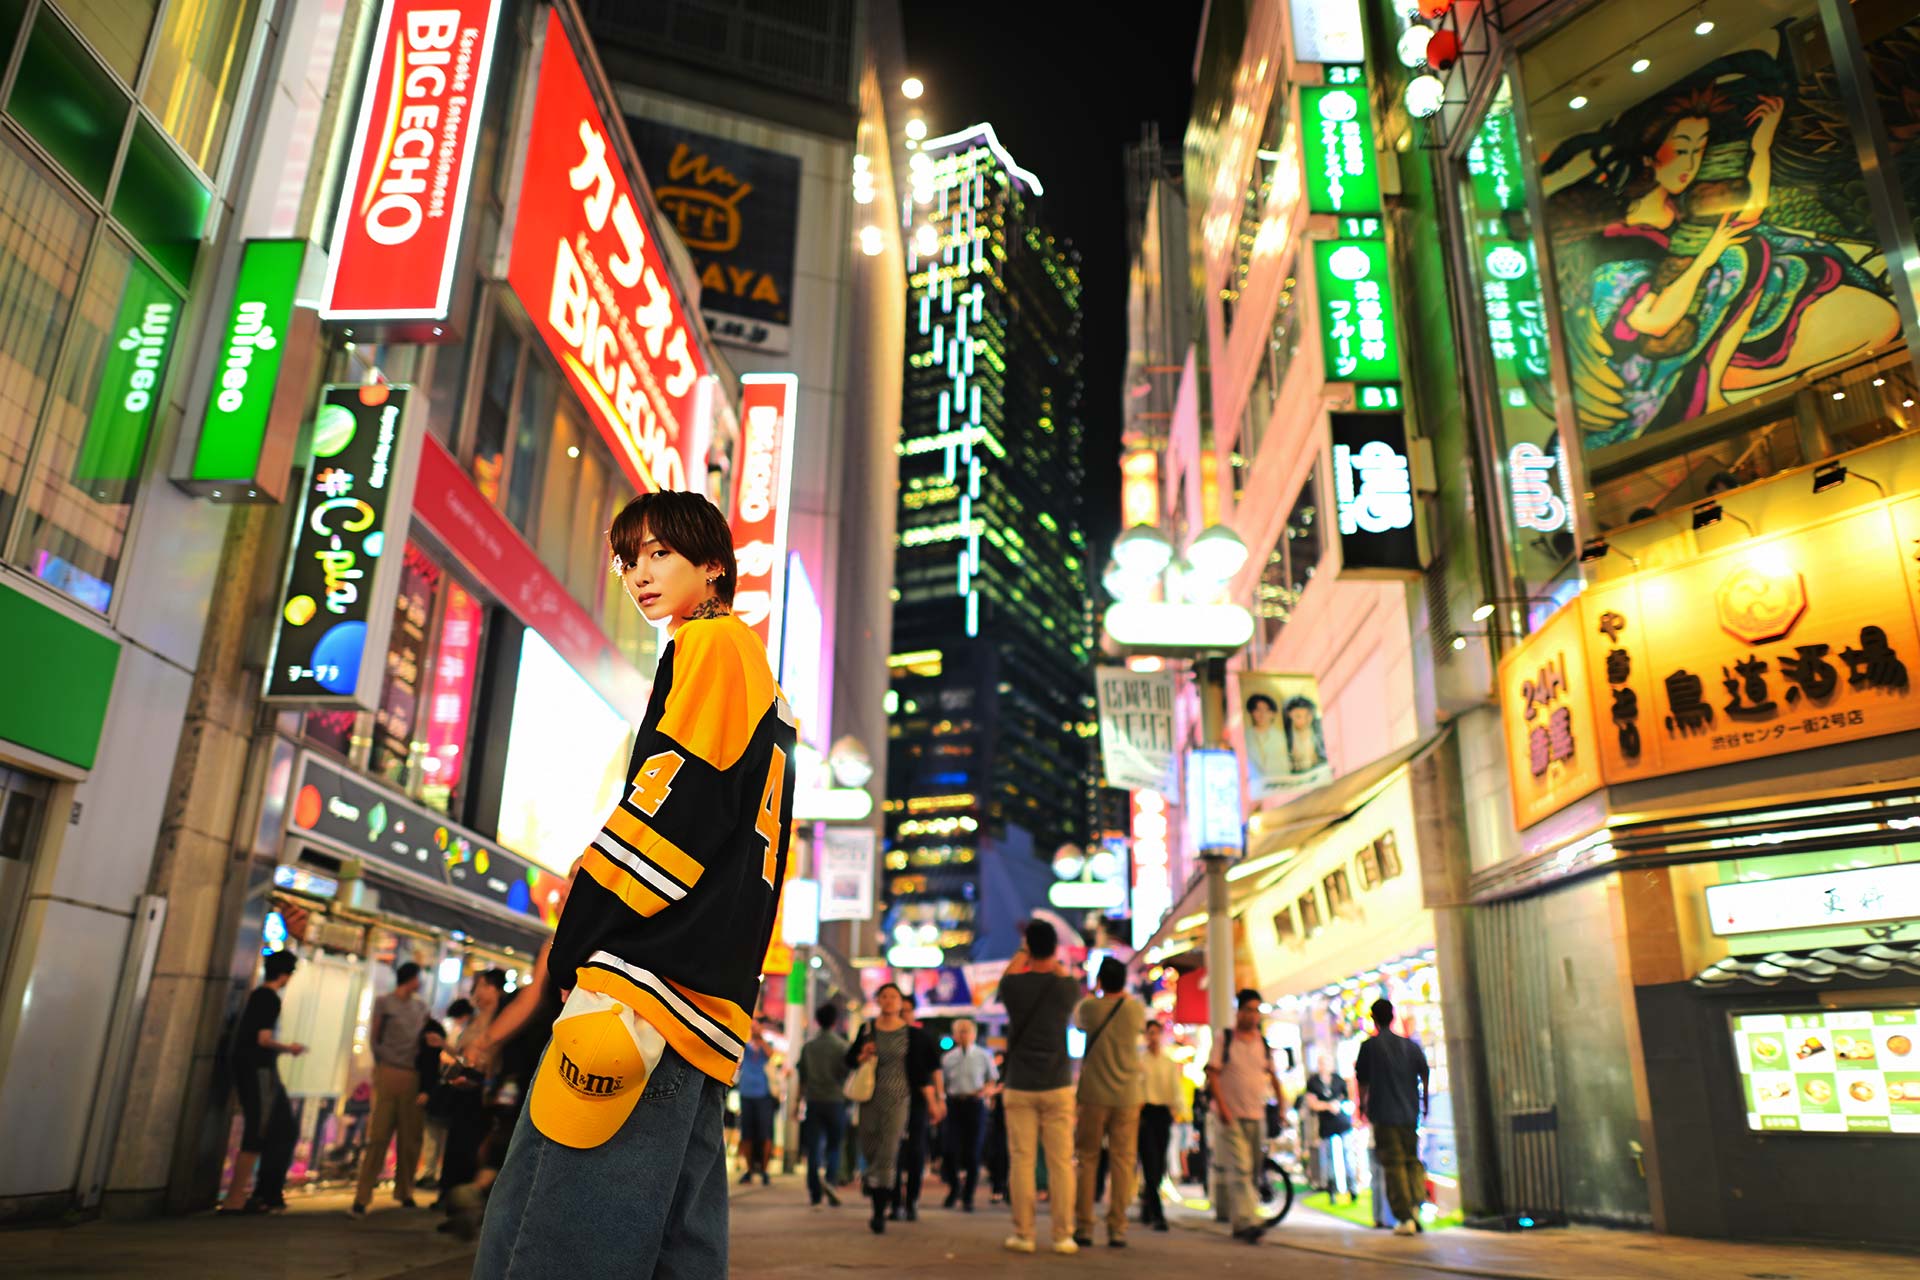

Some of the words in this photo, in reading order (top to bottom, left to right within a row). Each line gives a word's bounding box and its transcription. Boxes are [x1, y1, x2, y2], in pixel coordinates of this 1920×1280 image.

[406, 9, 461, 98] BIG
[453, 27, 479, 91] Karaoke
[1329, 66, 1361, 84] 2F
[366, 105, 440, 245] ECHO
[569, 118, 697, 399] カラオケ
[1345, 218, 1378, 236] 1F
[217, 301, 277, 413] mineo
[550, 237, 619, 394] BIG
[615, 359, 686, 492] ECHO
[1328, 299, 1358, 377] フルーツ
[1363, 387, 1398, 407] B1
[627, 749, 686, 819] 4
[754, 742, 786, 892] 4
